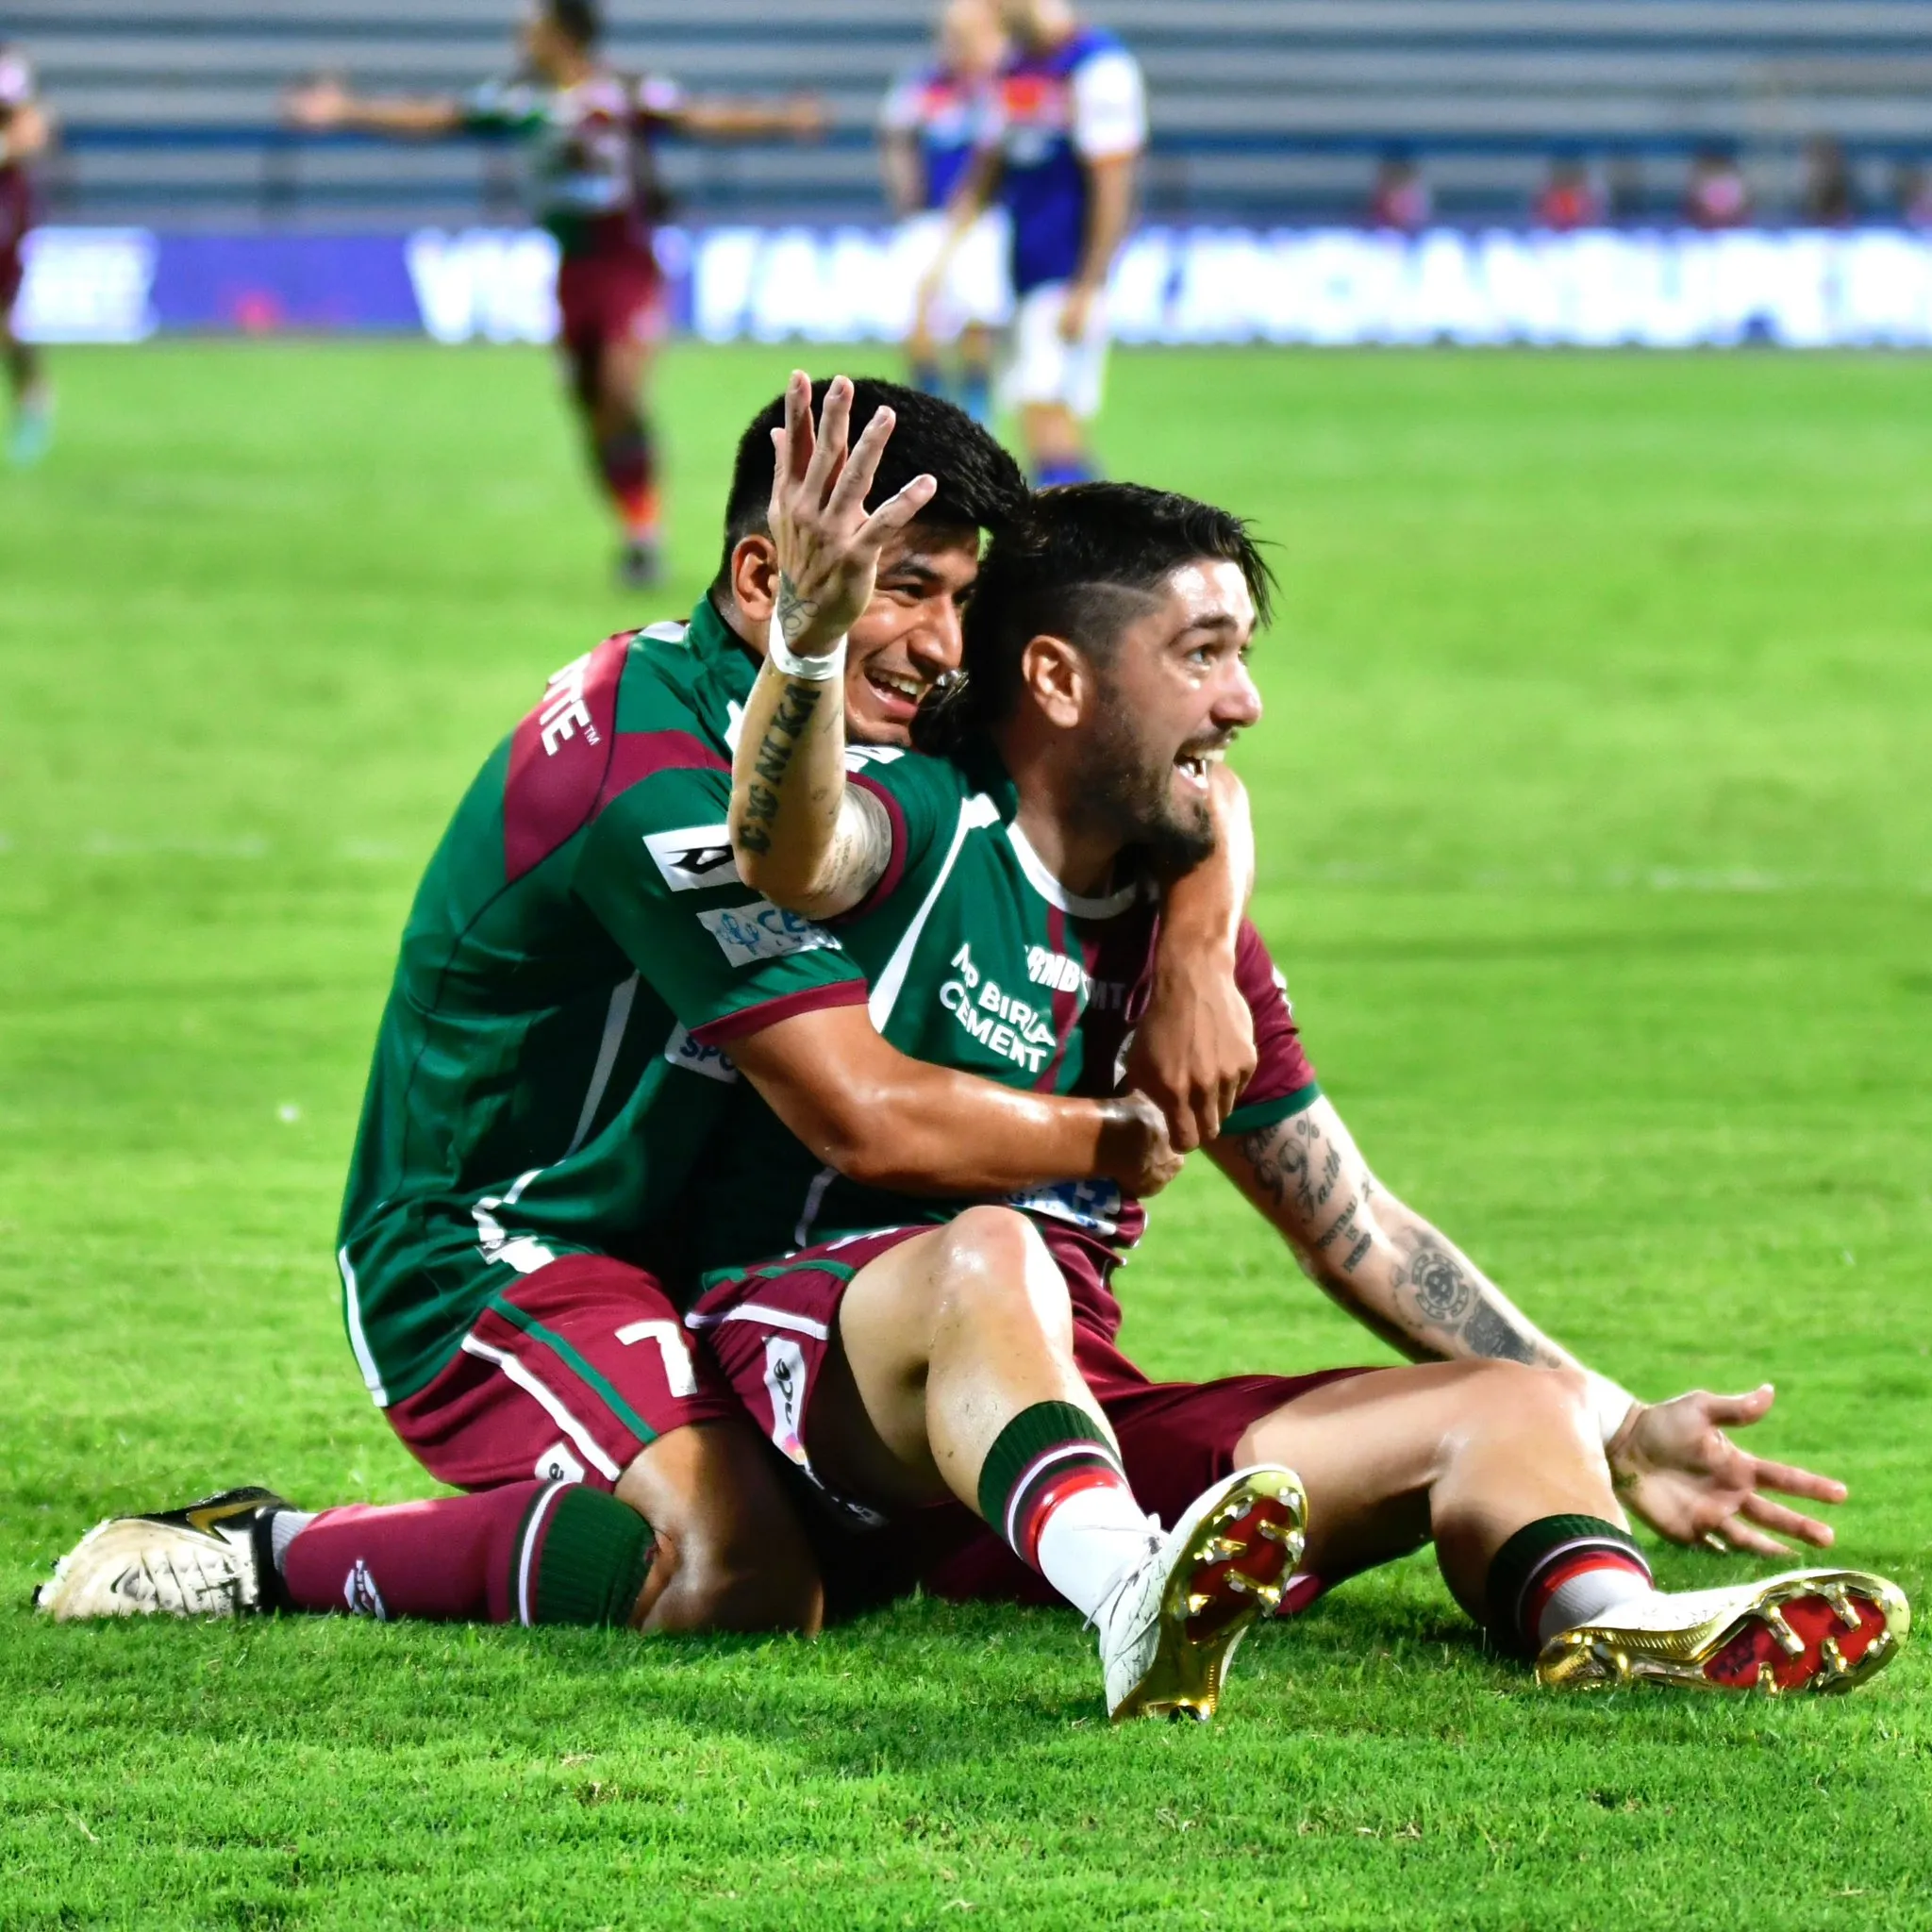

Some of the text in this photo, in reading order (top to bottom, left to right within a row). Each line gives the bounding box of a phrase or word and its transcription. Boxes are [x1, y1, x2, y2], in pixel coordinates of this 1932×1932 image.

[940, 981, 1047, 1073] CEMENT
[978, 981, 1056, 1047] BIRLA
[613, 1319, 698, 1398] 7
